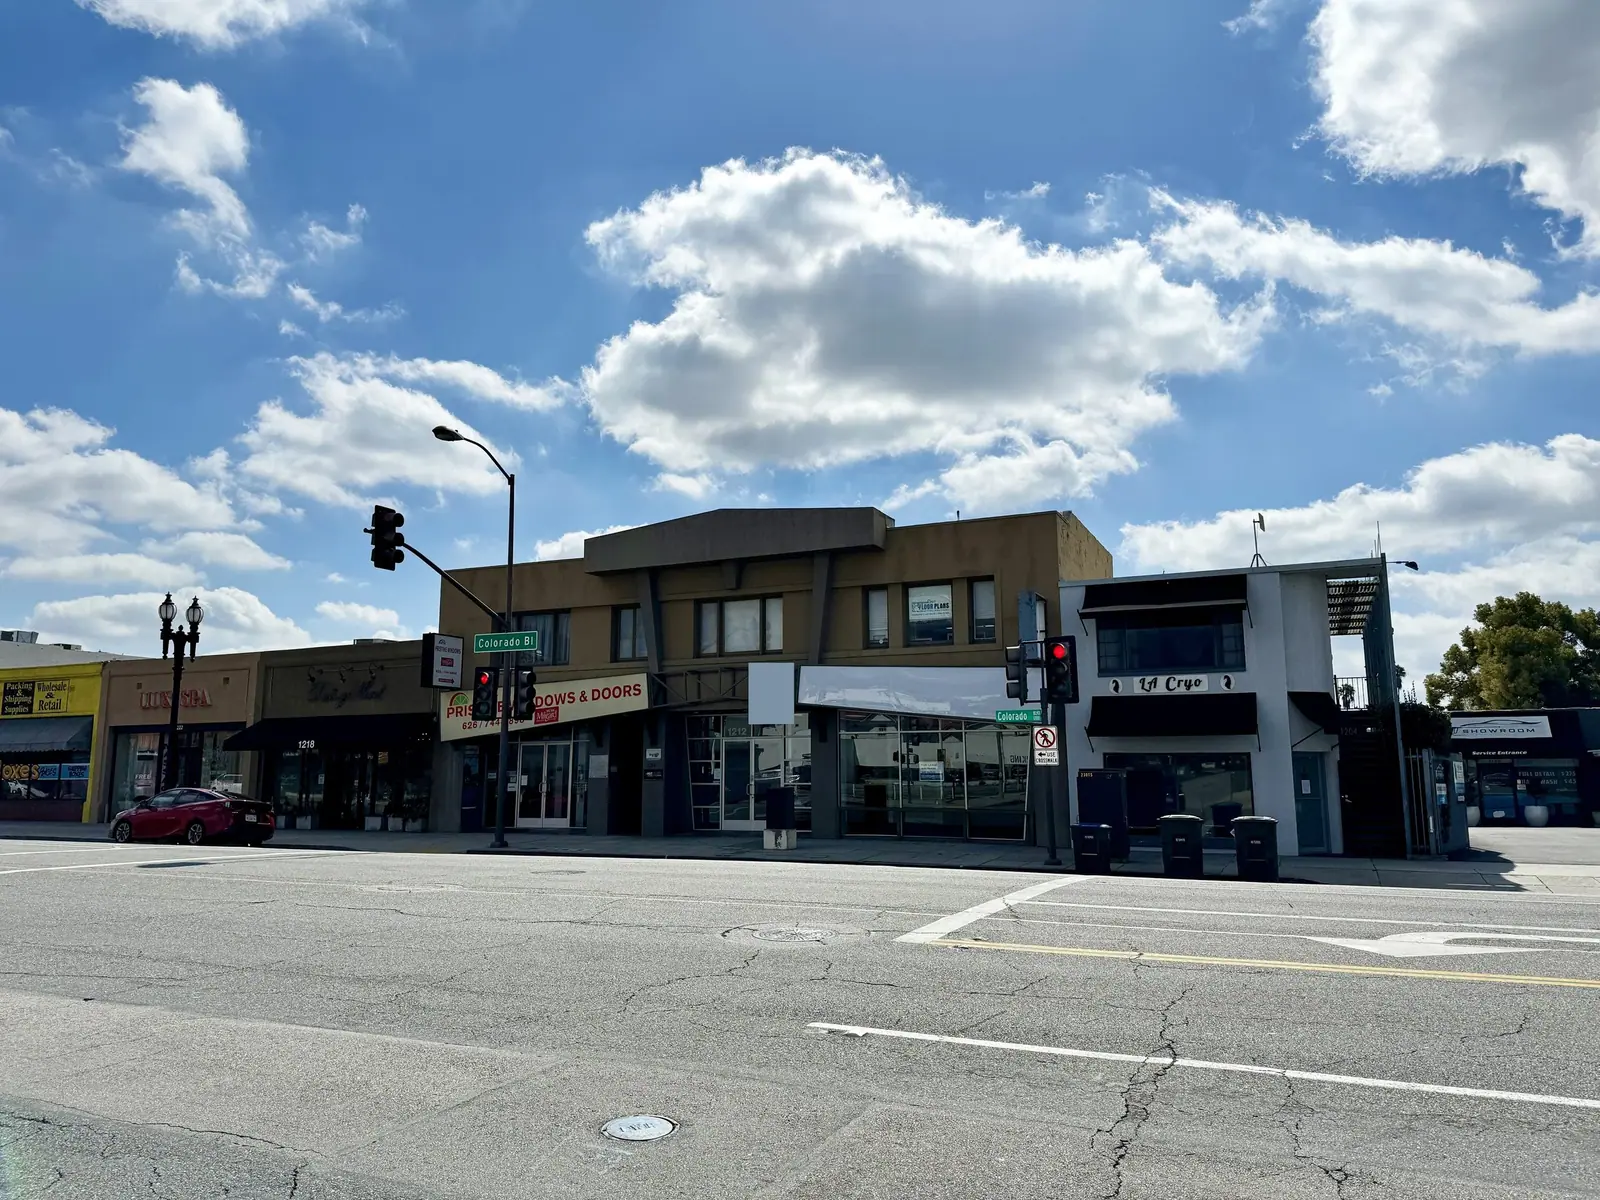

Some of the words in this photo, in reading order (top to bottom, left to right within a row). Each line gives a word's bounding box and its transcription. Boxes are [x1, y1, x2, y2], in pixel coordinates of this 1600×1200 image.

[478, 634, 520, 648] Colorado
[6, 682, 33, 691] Packing
[37, 681, 67, 692] Wholesale
[1139, 677, 1158, 692] LA
[1165, 675, 1203, 692] Cryo
[180, 688, 212, 708] SPA
[580, 690, 588, 703] &
[591, 683, 642, 700] DOORS
[5, 695, 32, 704] Shipping
[39, 698, 62, 711] Retail
[4, 705, 29, 715] Supplies
[997, 711, 1028, 721] Colorado
[727, 727, 747, 736] 1212
[298, 740, 315, 748] 1218
